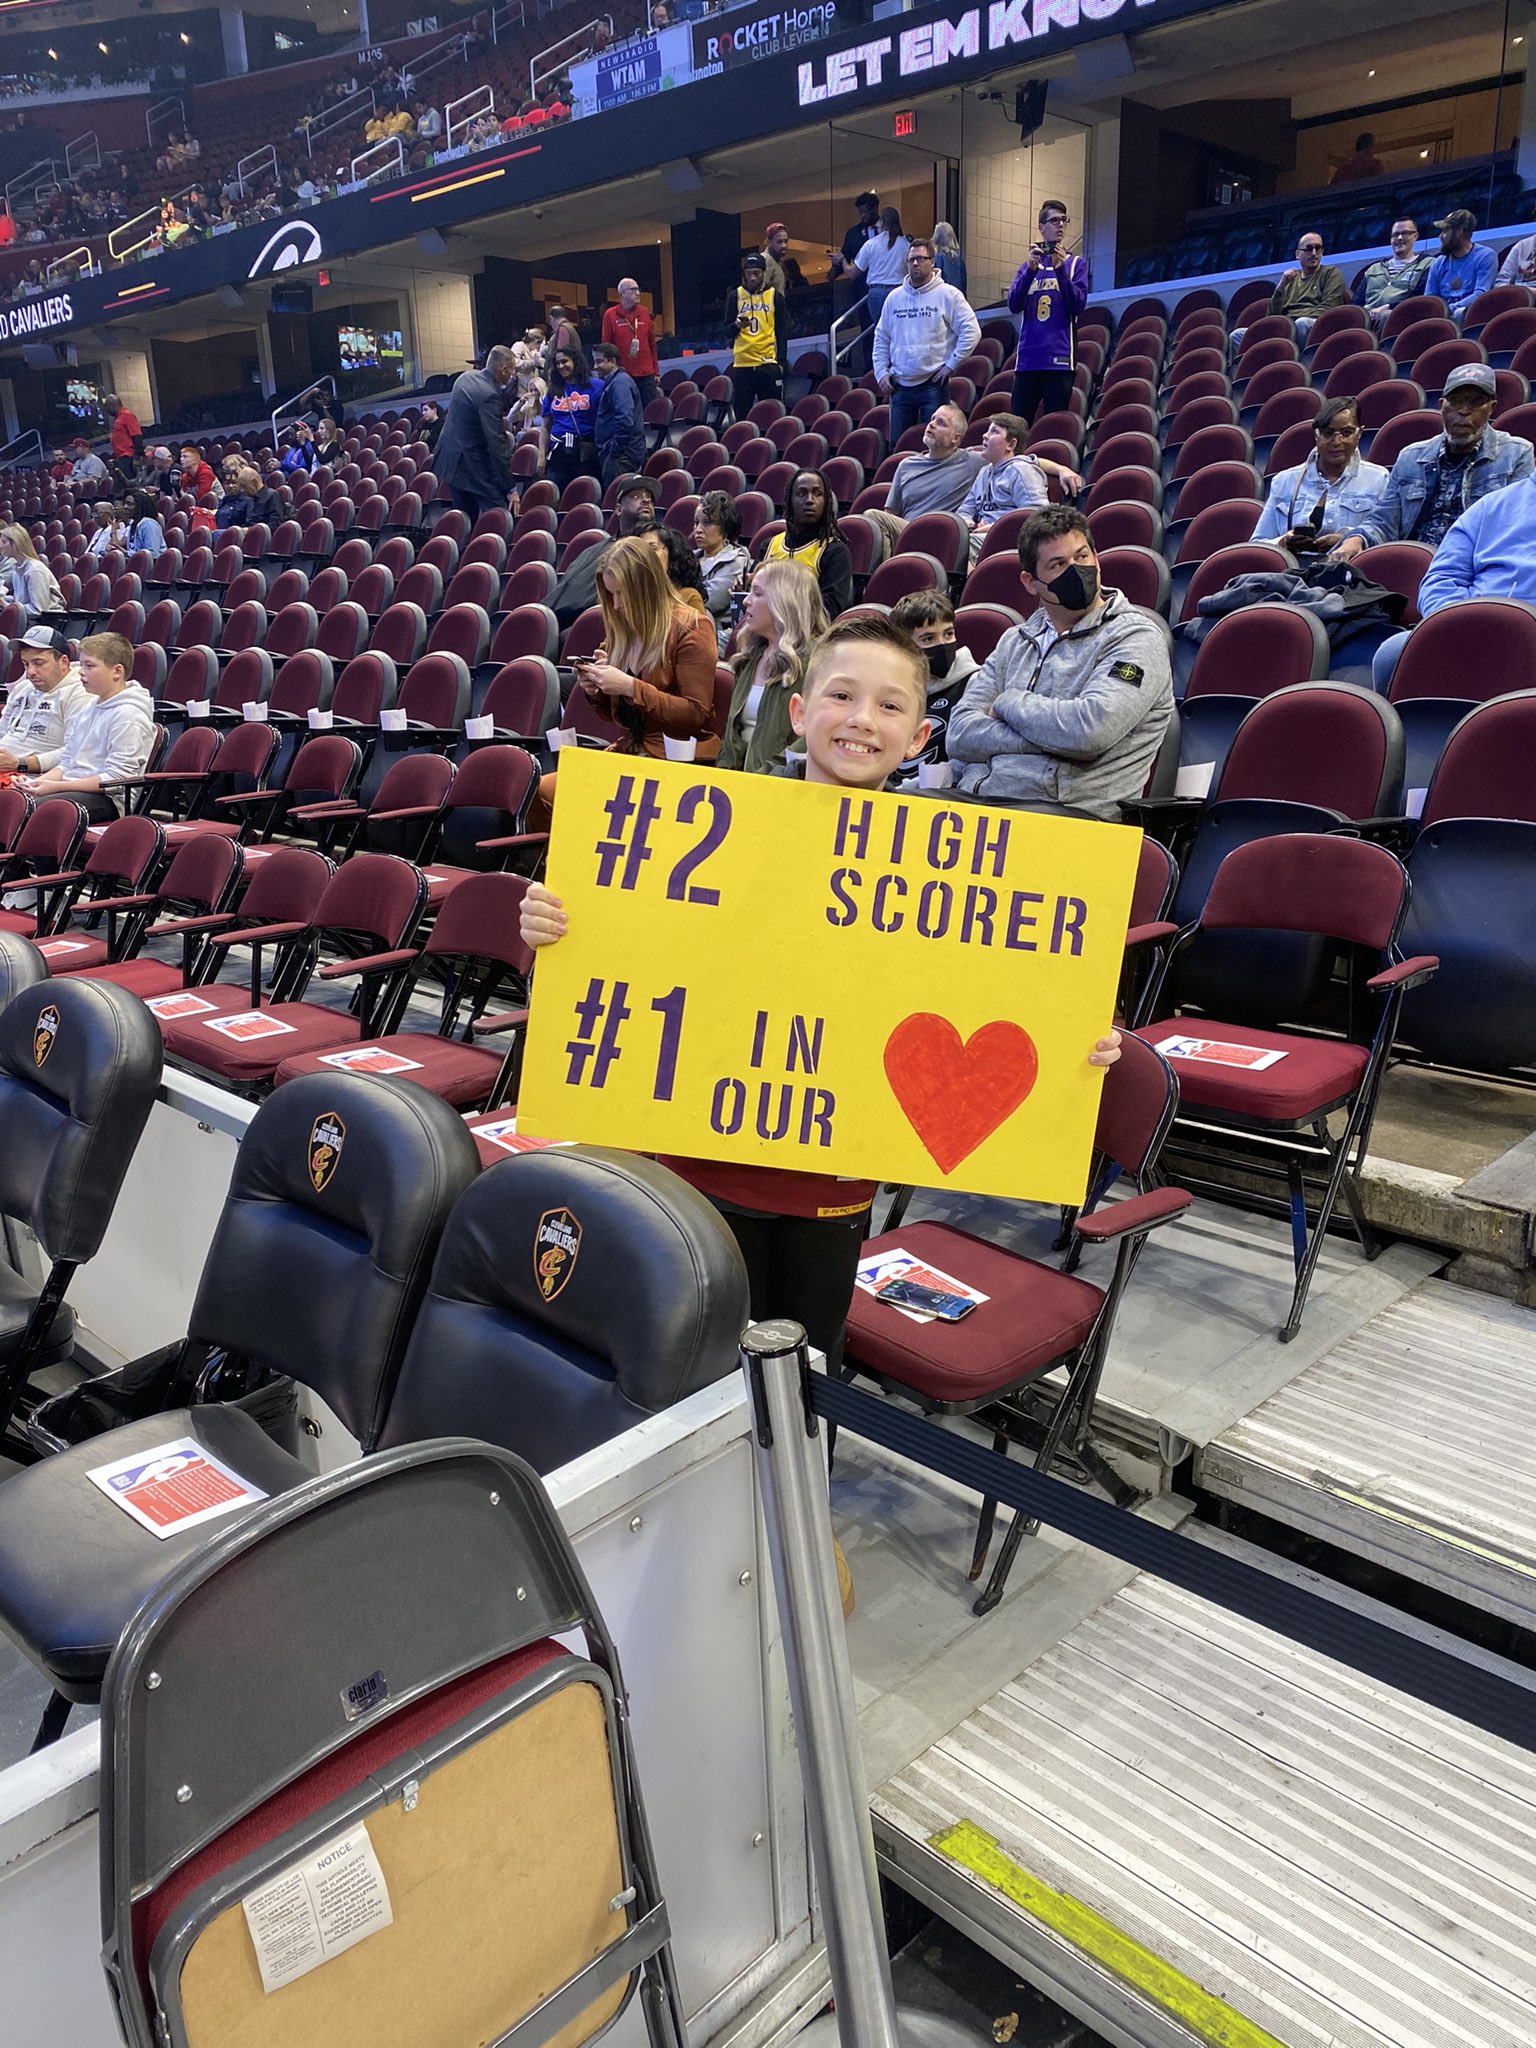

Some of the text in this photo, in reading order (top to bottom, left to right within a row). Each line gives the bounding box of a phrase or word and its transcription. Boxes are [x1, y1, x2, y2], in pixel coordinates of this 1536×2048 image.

[707, 1, 835, 60] ROCKET Home
[752, 38, 782, 59] CLUB
[601, 41, 654, 69] NEWSRADIO
[798, 36, 892, 106] LET
[899, 8, 980, 76] EM
[611, 59, 646, 91] WTAM
[617, 93, 627, 105] AM
[647, 83, 657, 93] FM
[896, 112, 912, 136] EXIT
[10, 294, 73, 336] CAVALIERS
[1037, 295, 1051, 321] 6
[595, 775, 733, 906] #2
[833, 797, 1011, 878] HIGH
[826, 868, 1088, 957] SCORER
[565, 978, 687, 1102] #1
[750, 1011, 824, 1075] IN
[711, 1077, 837, 1148] OUR
[539, 1225, 577, 1256] CAVALIERS
[348, 1678, 377, 1703] clarin
[317, 1841, 352, 1871] NOTICE
